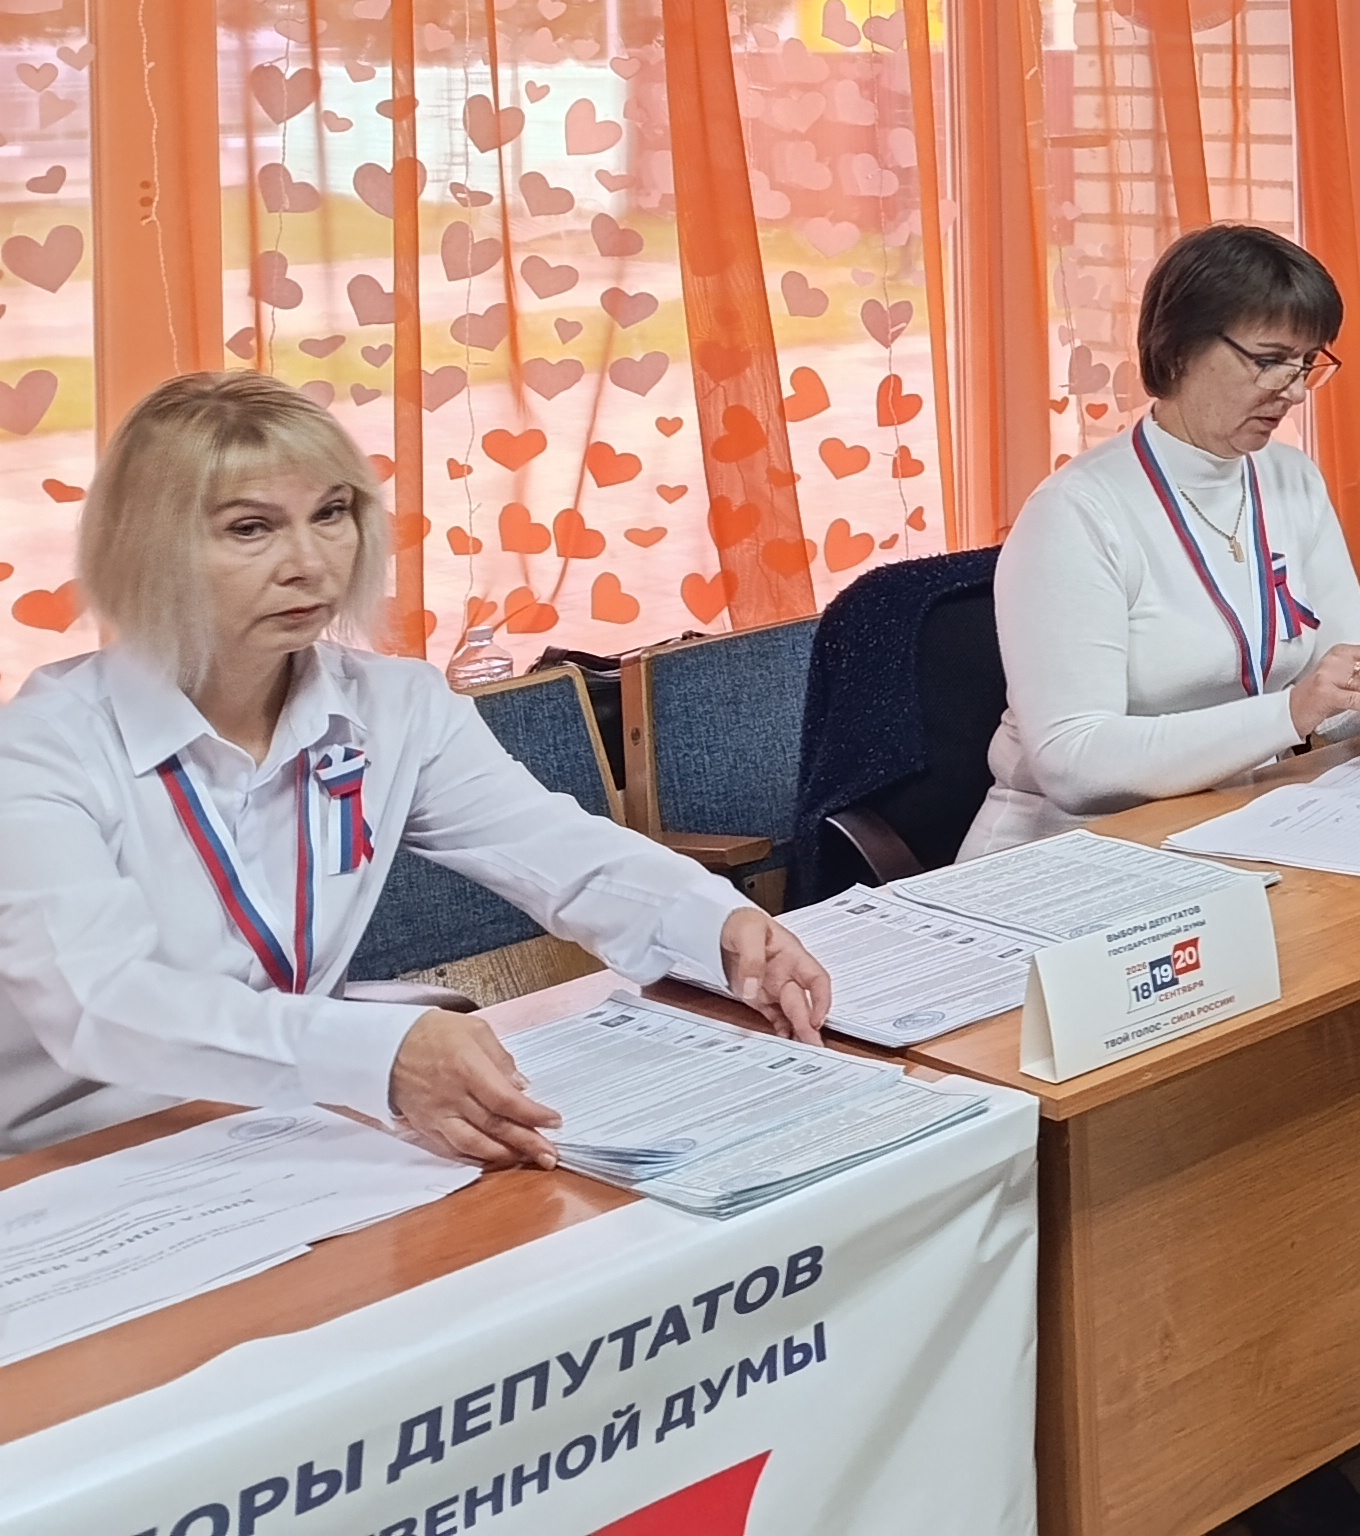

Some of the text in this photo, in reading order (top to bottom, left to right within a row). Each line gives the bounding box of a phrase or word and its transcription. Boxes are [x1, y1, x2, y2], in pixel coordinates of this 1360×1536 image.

[1106, 905, 1201, 942] ВЫБОРЫ ДЕПУТАТОВ
[1125, 961, 1148, 975] 2026
[1132, 946, 1197, 1002] 18 19 20
[1158, 980, 1204, 1002] СЕНТЯБРЯ
[1104, 1033, 1130, 1049] ТВОЙ
[1131, 1022, 1163, 1040] ГОЛОС
[1170, 1010, 1195, 1025] СИЛА
[130, 1245, 824, 1536] ОРЫ ДЕПУТАТОВ
[366, 1321, 828, 1536] ВЕННОЙ ДУМЫ
